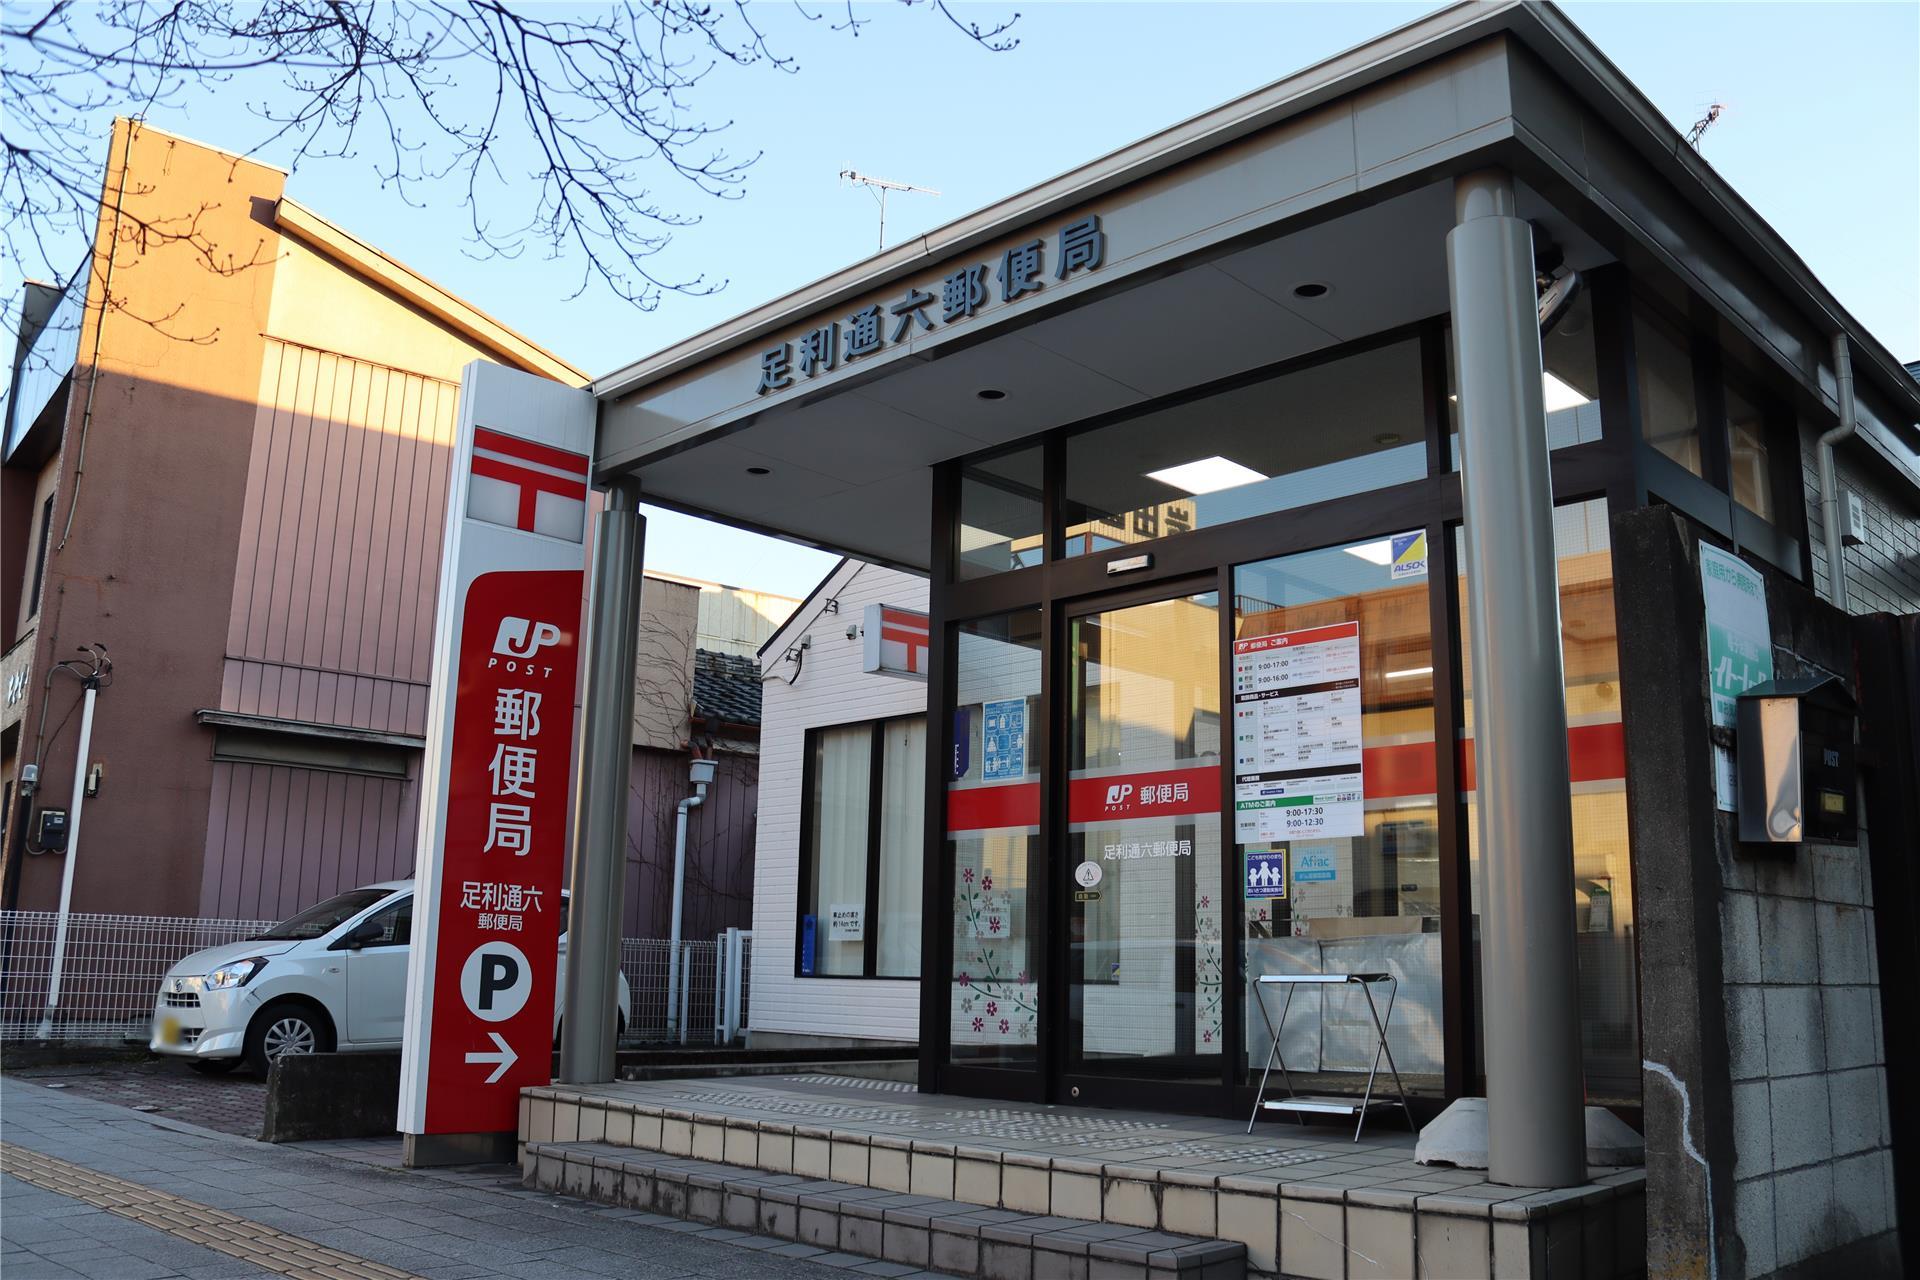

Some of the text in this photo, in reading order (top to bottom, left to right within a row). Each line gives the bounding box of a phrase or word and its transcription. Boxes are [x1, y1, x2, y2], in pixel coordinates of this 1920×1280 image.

[756, 214, 1104, 396] 足利通六郵便局
[488, 657, 552, 678] POST
[1258, 661, 1289, 671] 9:00-17:00
[1258, 674, 1289, 684] 9:00-16:00
[483, 688, 543, 857] 郵便局
[1140, 782, 1189, 806] 郵便局
[1104, 804, 1132, 812] POST
[1286, 807, 1324, 817] 9:00-17:30
[1286, 818, 1324, 828] 9:00-12:30
[1103, 839, 1192, 861] 足利通六郵便局
[460, 881, 544, 913] 足利通六
[477, 913, 523, 931] 郵便局
[478, 953, 520, 1010] P
